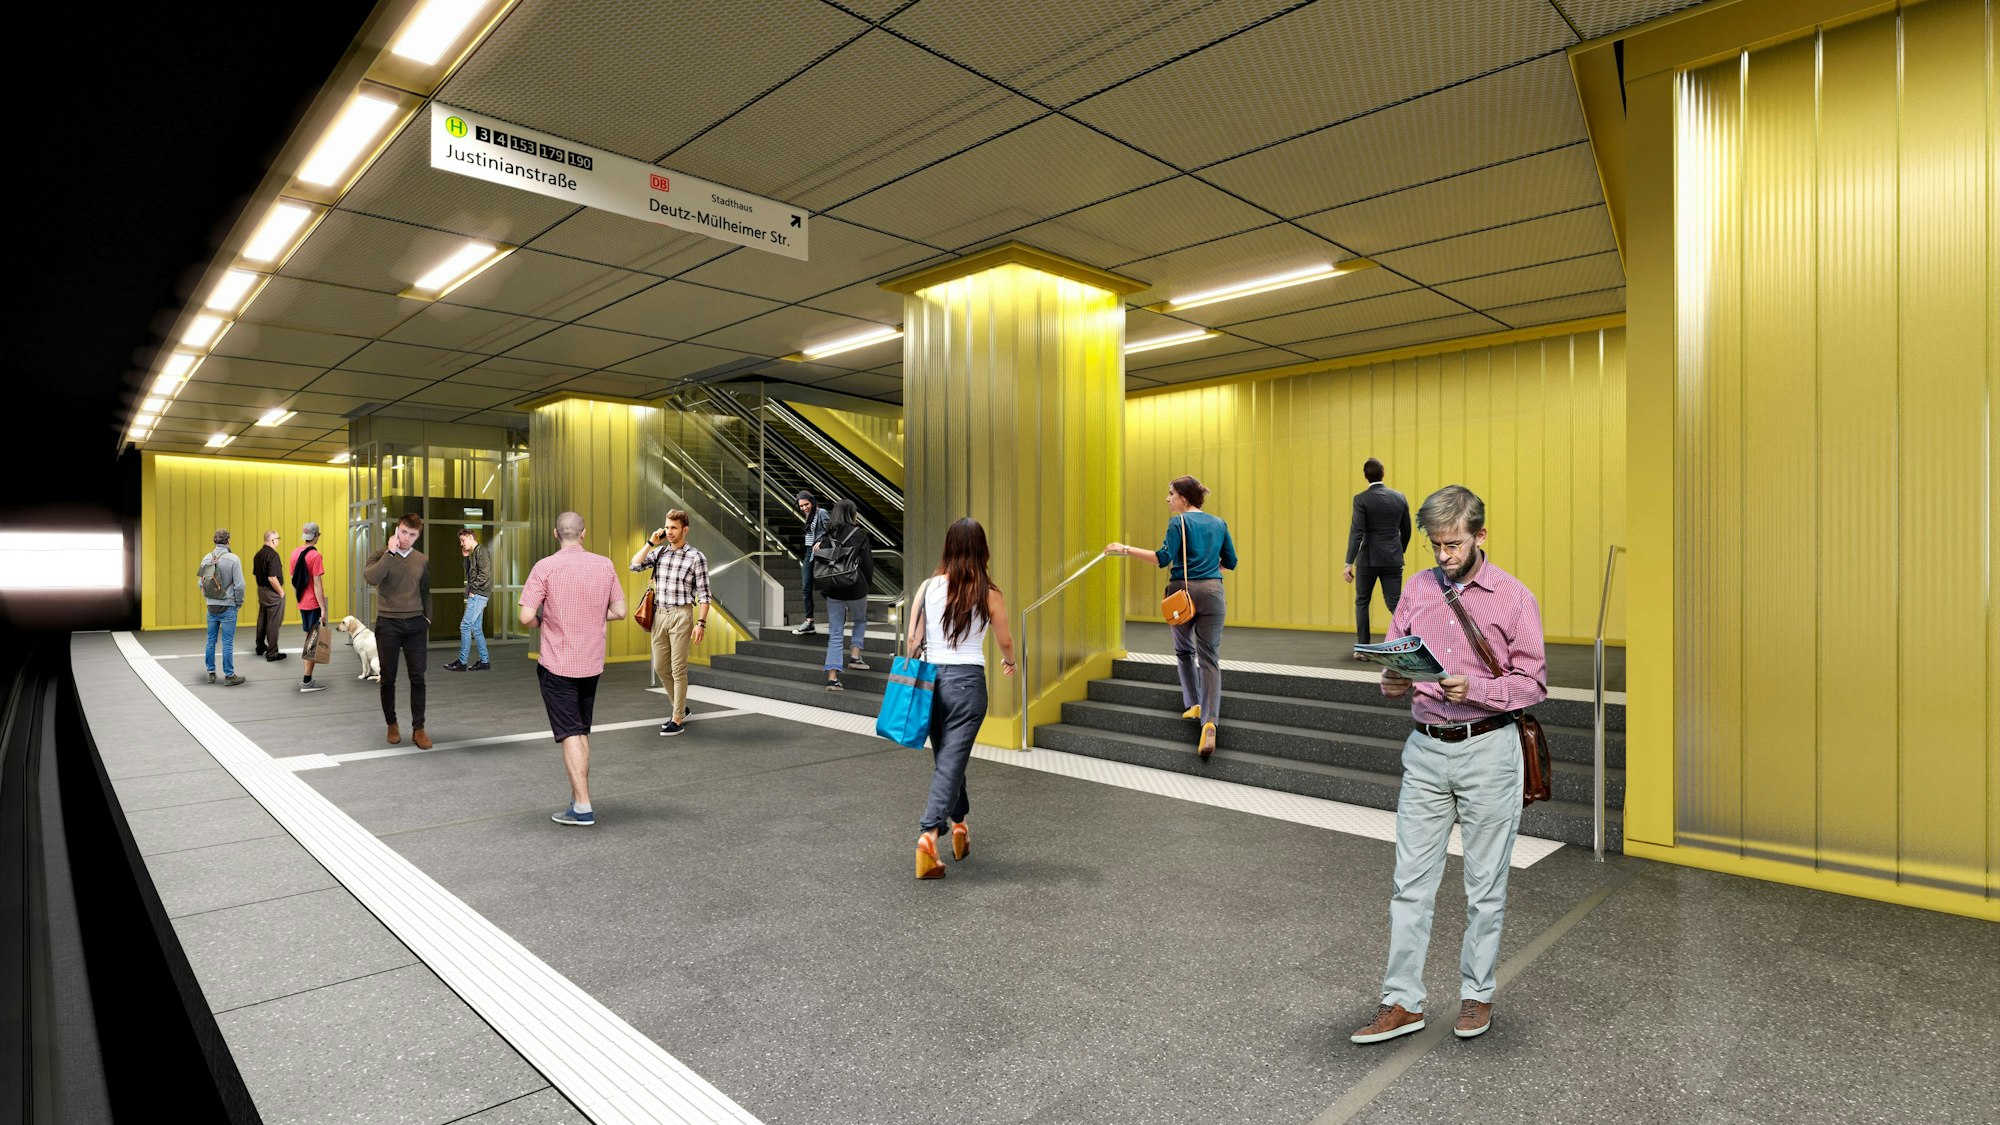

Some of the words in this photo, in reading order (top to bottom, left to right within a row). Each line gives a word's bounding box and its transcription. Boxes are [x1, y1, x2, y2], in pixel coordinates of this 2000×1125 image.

[446, 144, 577, 191] Justinianstraße
[450, 119, 463, 135] H
[480, 128, 489, 141] 3
[497, 134, 506, 146] 4
[512, 138, 535, 154] 153
[541, 146, 564, 162] 179
[569, 154, 591, 169] 190
[651, 176, 668, 191] DB
[711, 194, 753, 213] Stadthaus
[650, 198, 767, 240] Deutz-Mülheimer
[770, 230, 790, 247] Str.
